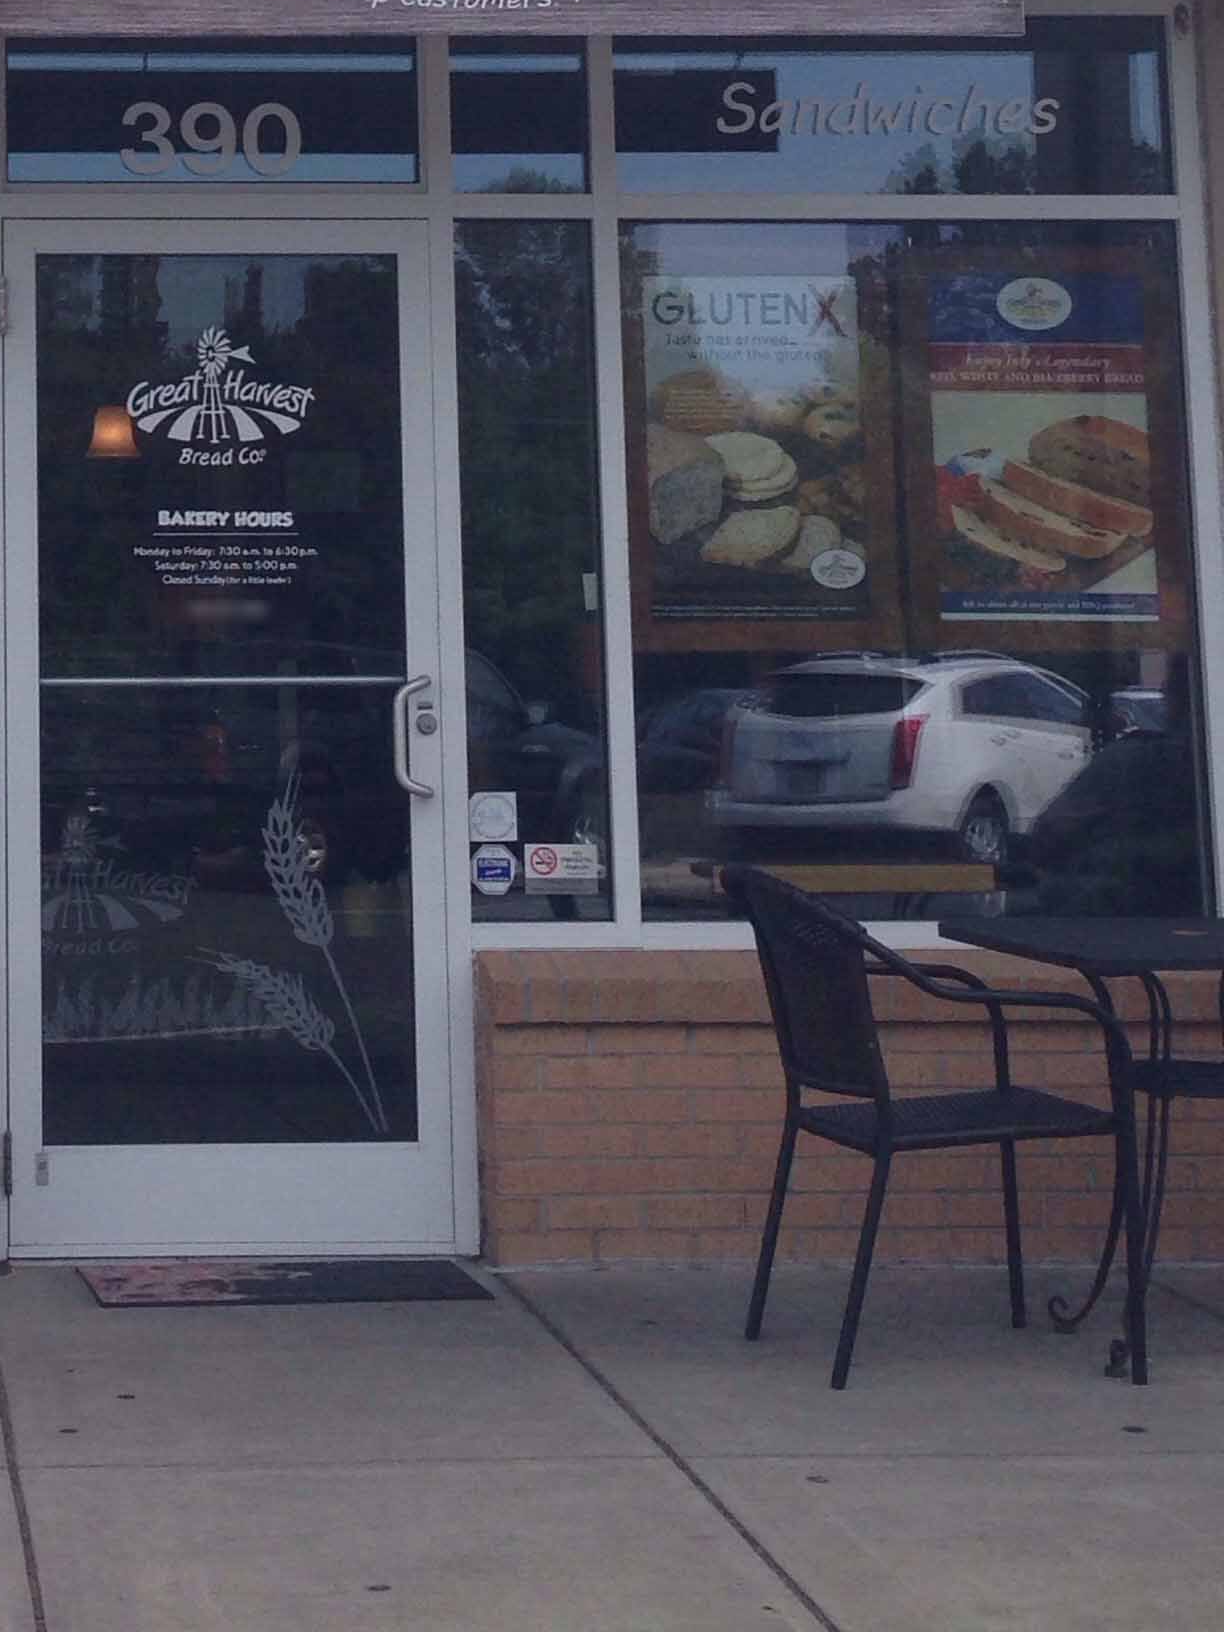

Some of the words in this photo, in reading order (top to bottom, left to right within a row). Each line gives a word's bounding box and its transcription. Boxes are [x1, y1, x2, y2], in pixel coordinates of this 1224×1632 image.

[715, 80, 1061, 137] Sandwiches
[119, 100, 302, 177] 390
[127, 368, 204, 418] Great
[223, 368, 316, 418] Harvest
[178, 446, 233, 466] Bread
[157, 510, 229, 528] BAKERY
[234, 511, 294, 528] HOURS
[133, 546, 170, 558] Monday
[172, 547, 182, 556] to
[263, 546, 273, 556] to
[242, 560, 253, 570] to
[161, 574, 193, 585] Closed
[194, 574, 225, 586] Sunday
